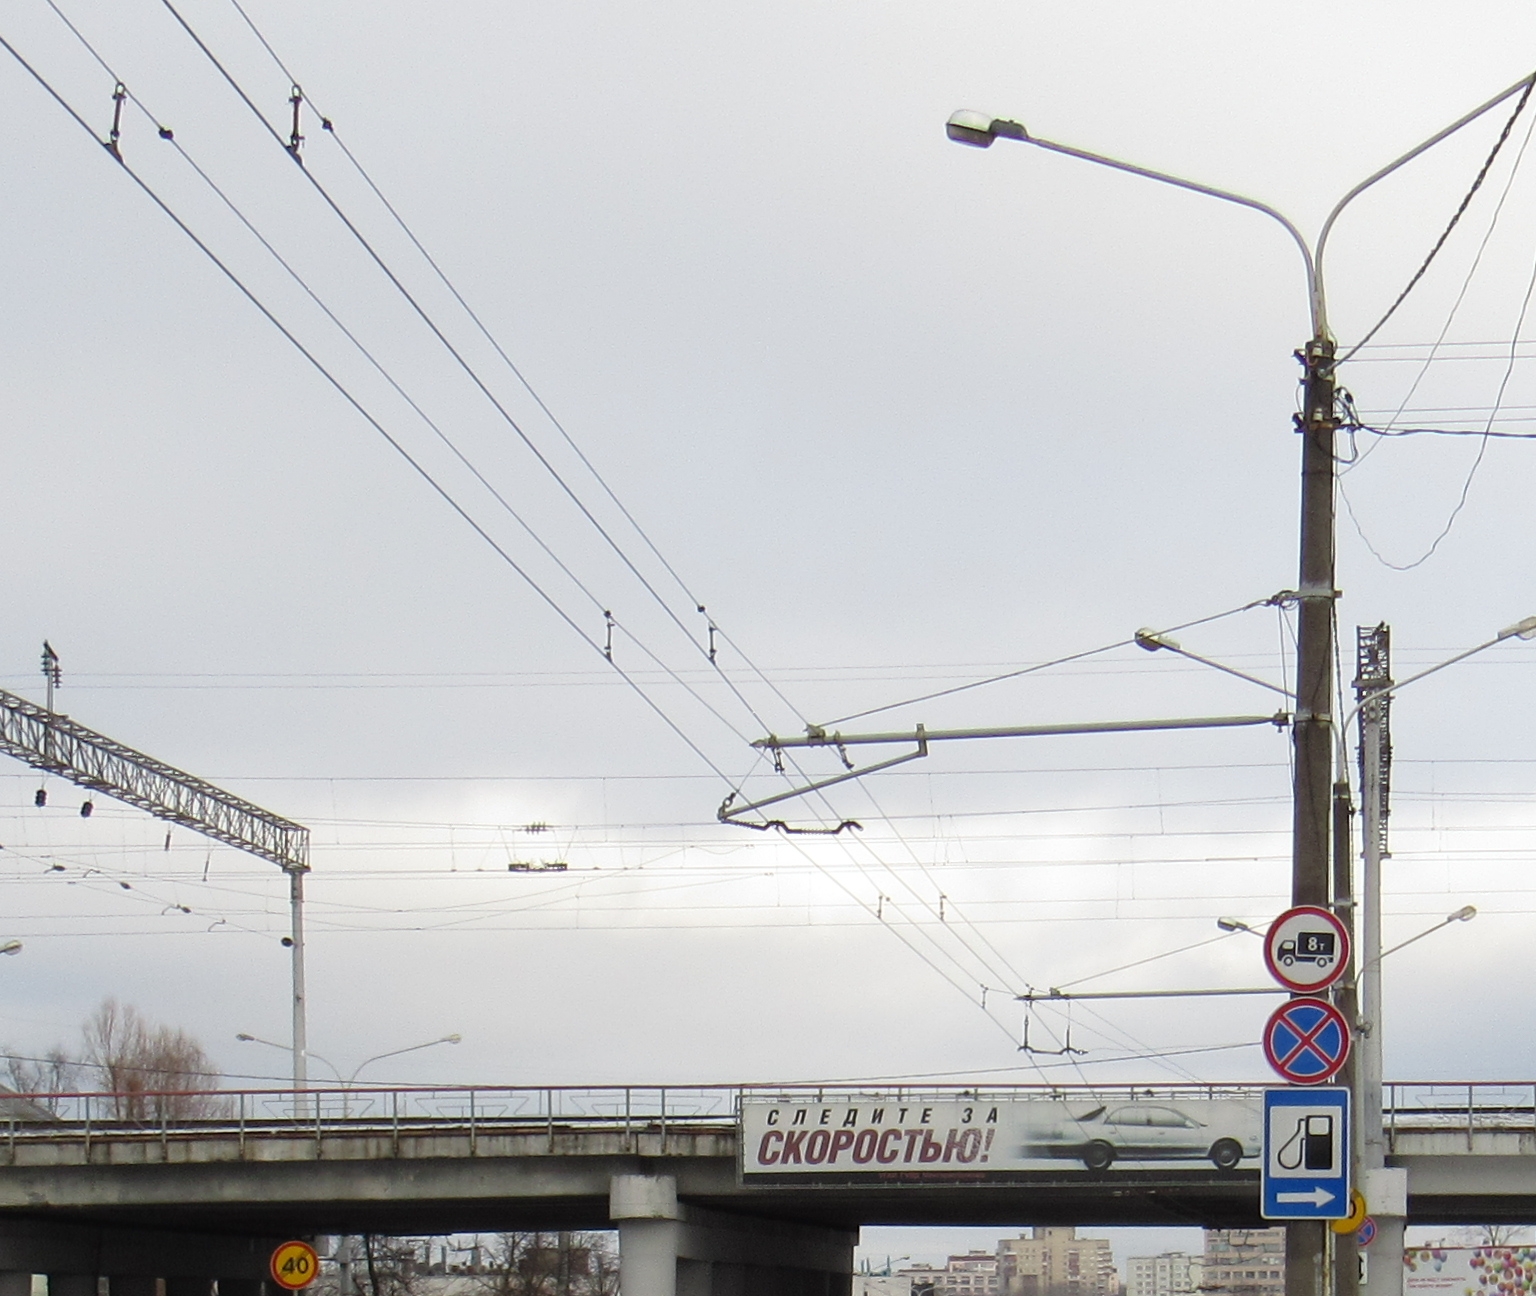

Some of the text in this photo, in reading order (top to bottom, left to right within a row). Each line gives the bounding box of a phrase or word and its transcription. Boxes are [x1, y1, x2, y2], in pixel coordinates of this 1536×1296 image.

[767, 1107, 999, 1127] СЛЕДИТЕ ЗА
[757, 1128, 996, 1165] СКОРОСТЬЮ!
[282, 1256, 309, 1275] 40
